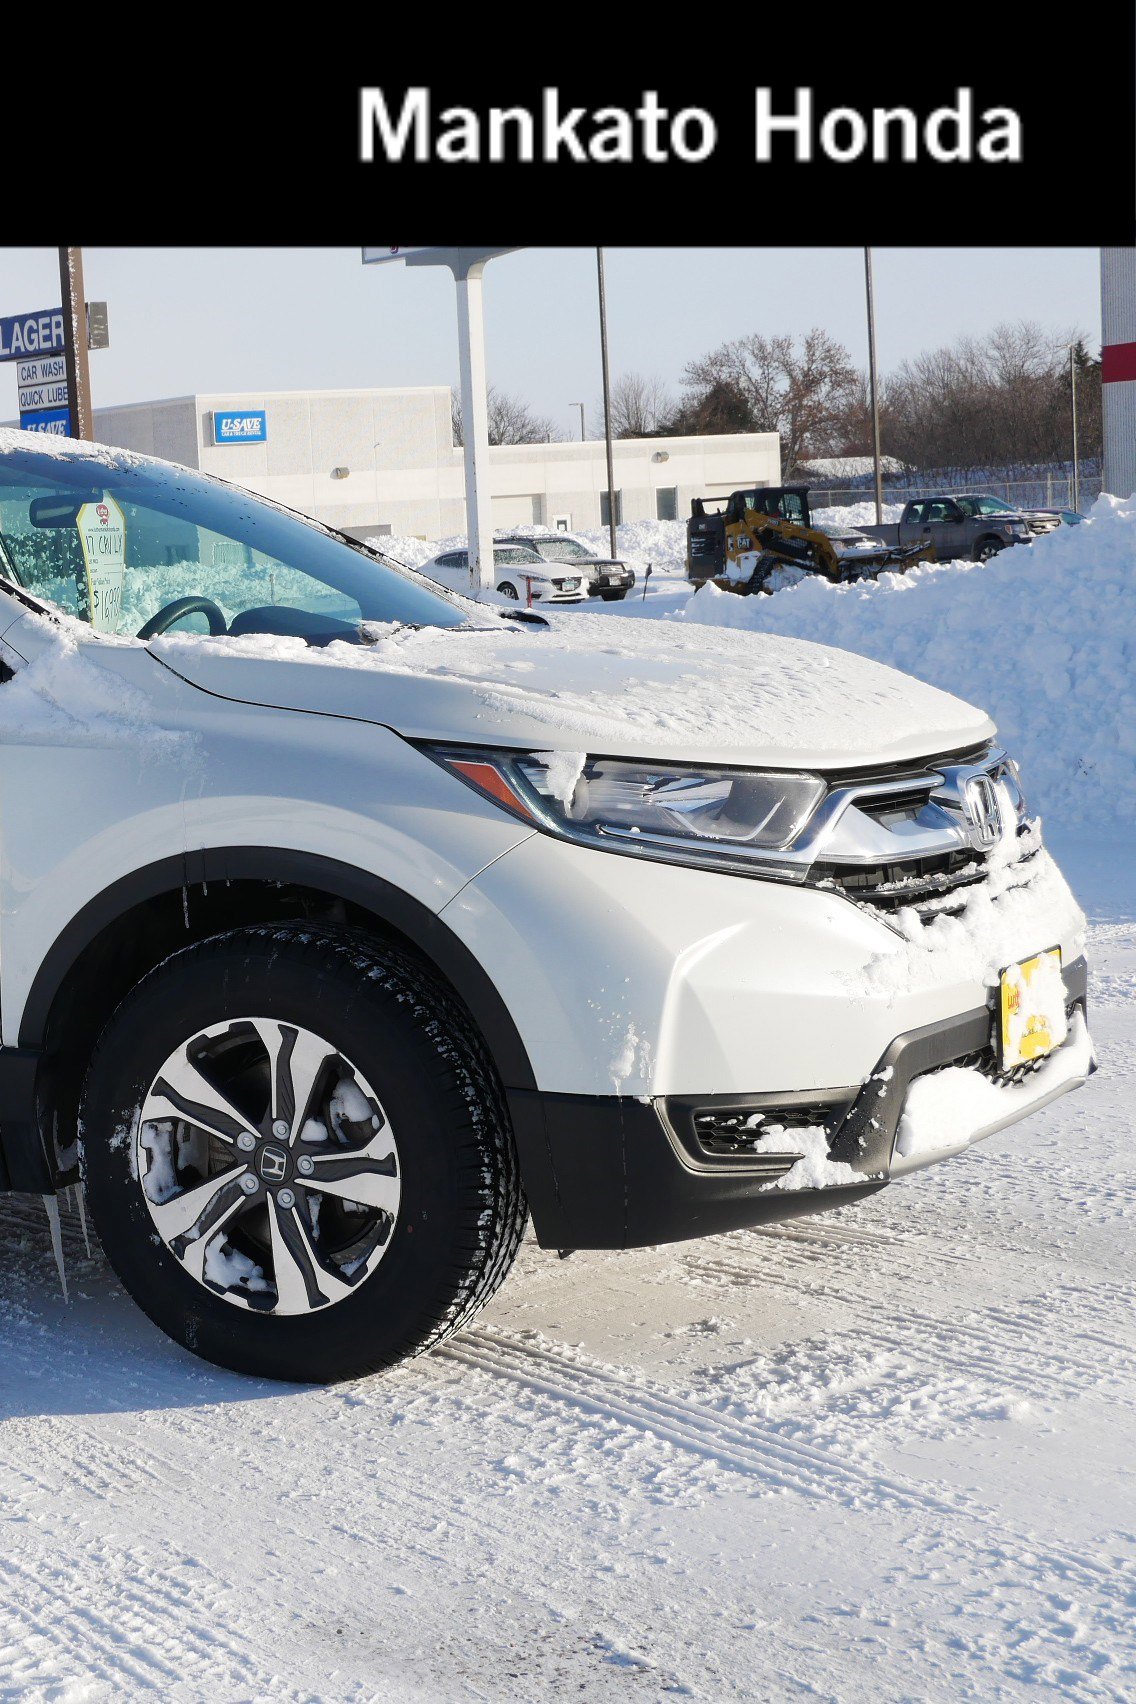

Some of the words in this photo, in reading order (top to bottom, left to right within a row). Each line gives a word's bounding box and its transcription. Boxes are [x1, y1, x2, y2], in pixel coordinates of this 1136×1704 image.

[20, 365, 38, 382] CAR
[40, 360, 64, 378] WASH
[20, 389, 45, 407] QUICK
[47, 385, 69, 403] LUBE
[221, 417, 262, 431] U-SAVE
[736, 537, 750, 549] CAT
